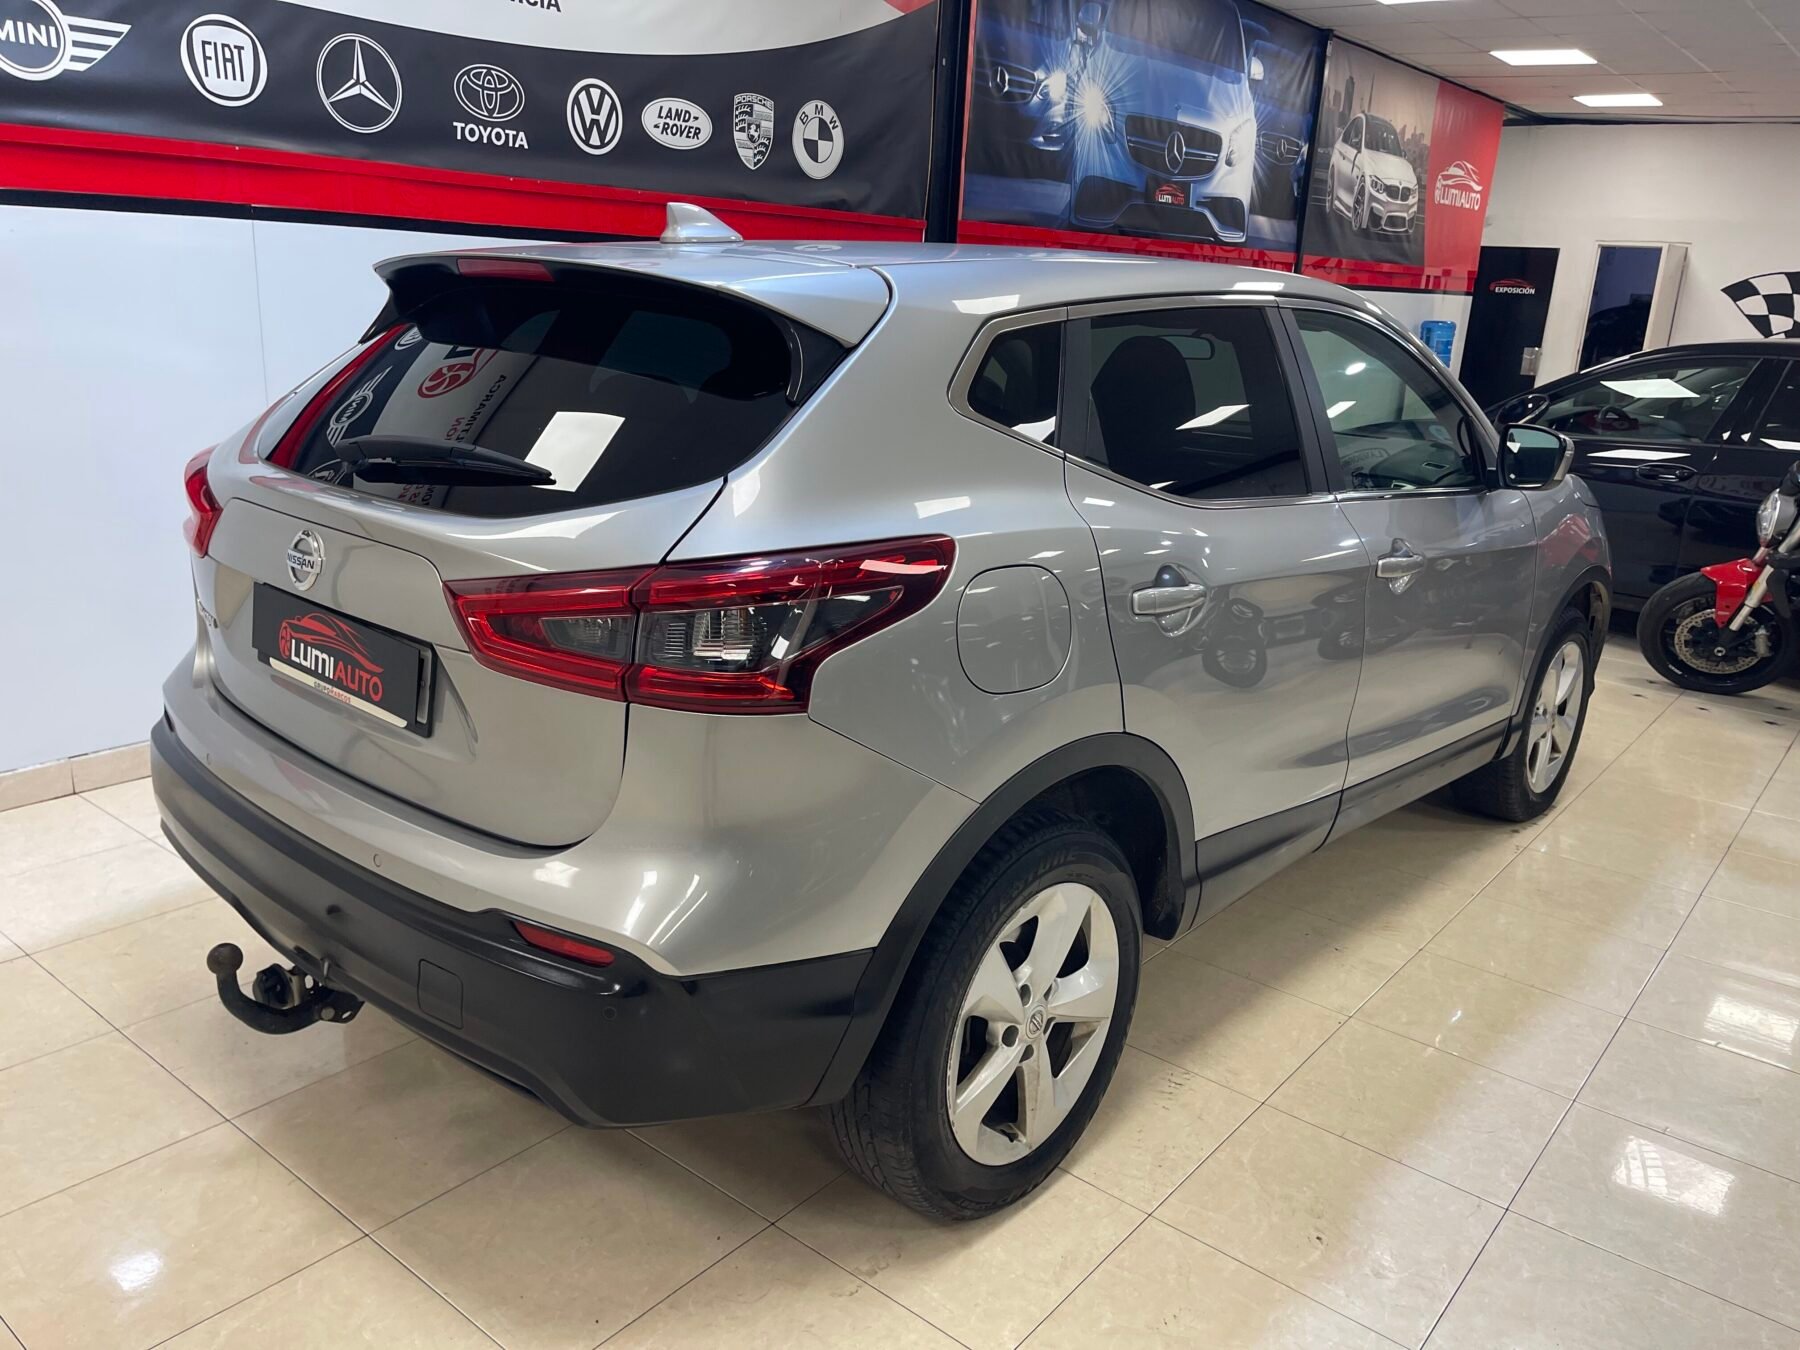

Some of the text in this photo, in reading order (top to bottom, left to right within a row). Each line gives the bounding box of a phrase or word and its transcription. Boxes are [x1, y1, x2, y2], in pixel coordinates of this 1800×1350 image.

[0, 18, 58, 48] MINI
[201, 40, 246, 82] FIAT
[735, 94, 773, 110] PORSCHE
[657, 105, 691, 124] LAND
[798, 103, 839, 131] BMW
[453, 121, 529, 149] TOYOTA
[660, 123, 702, 141] ROVER
[1494, 285, 1536, 295] EXPOSICIÓN
[288, 553, 315, 569] NISSAN
[290, 638, 384, 702] LUMIAUTO
